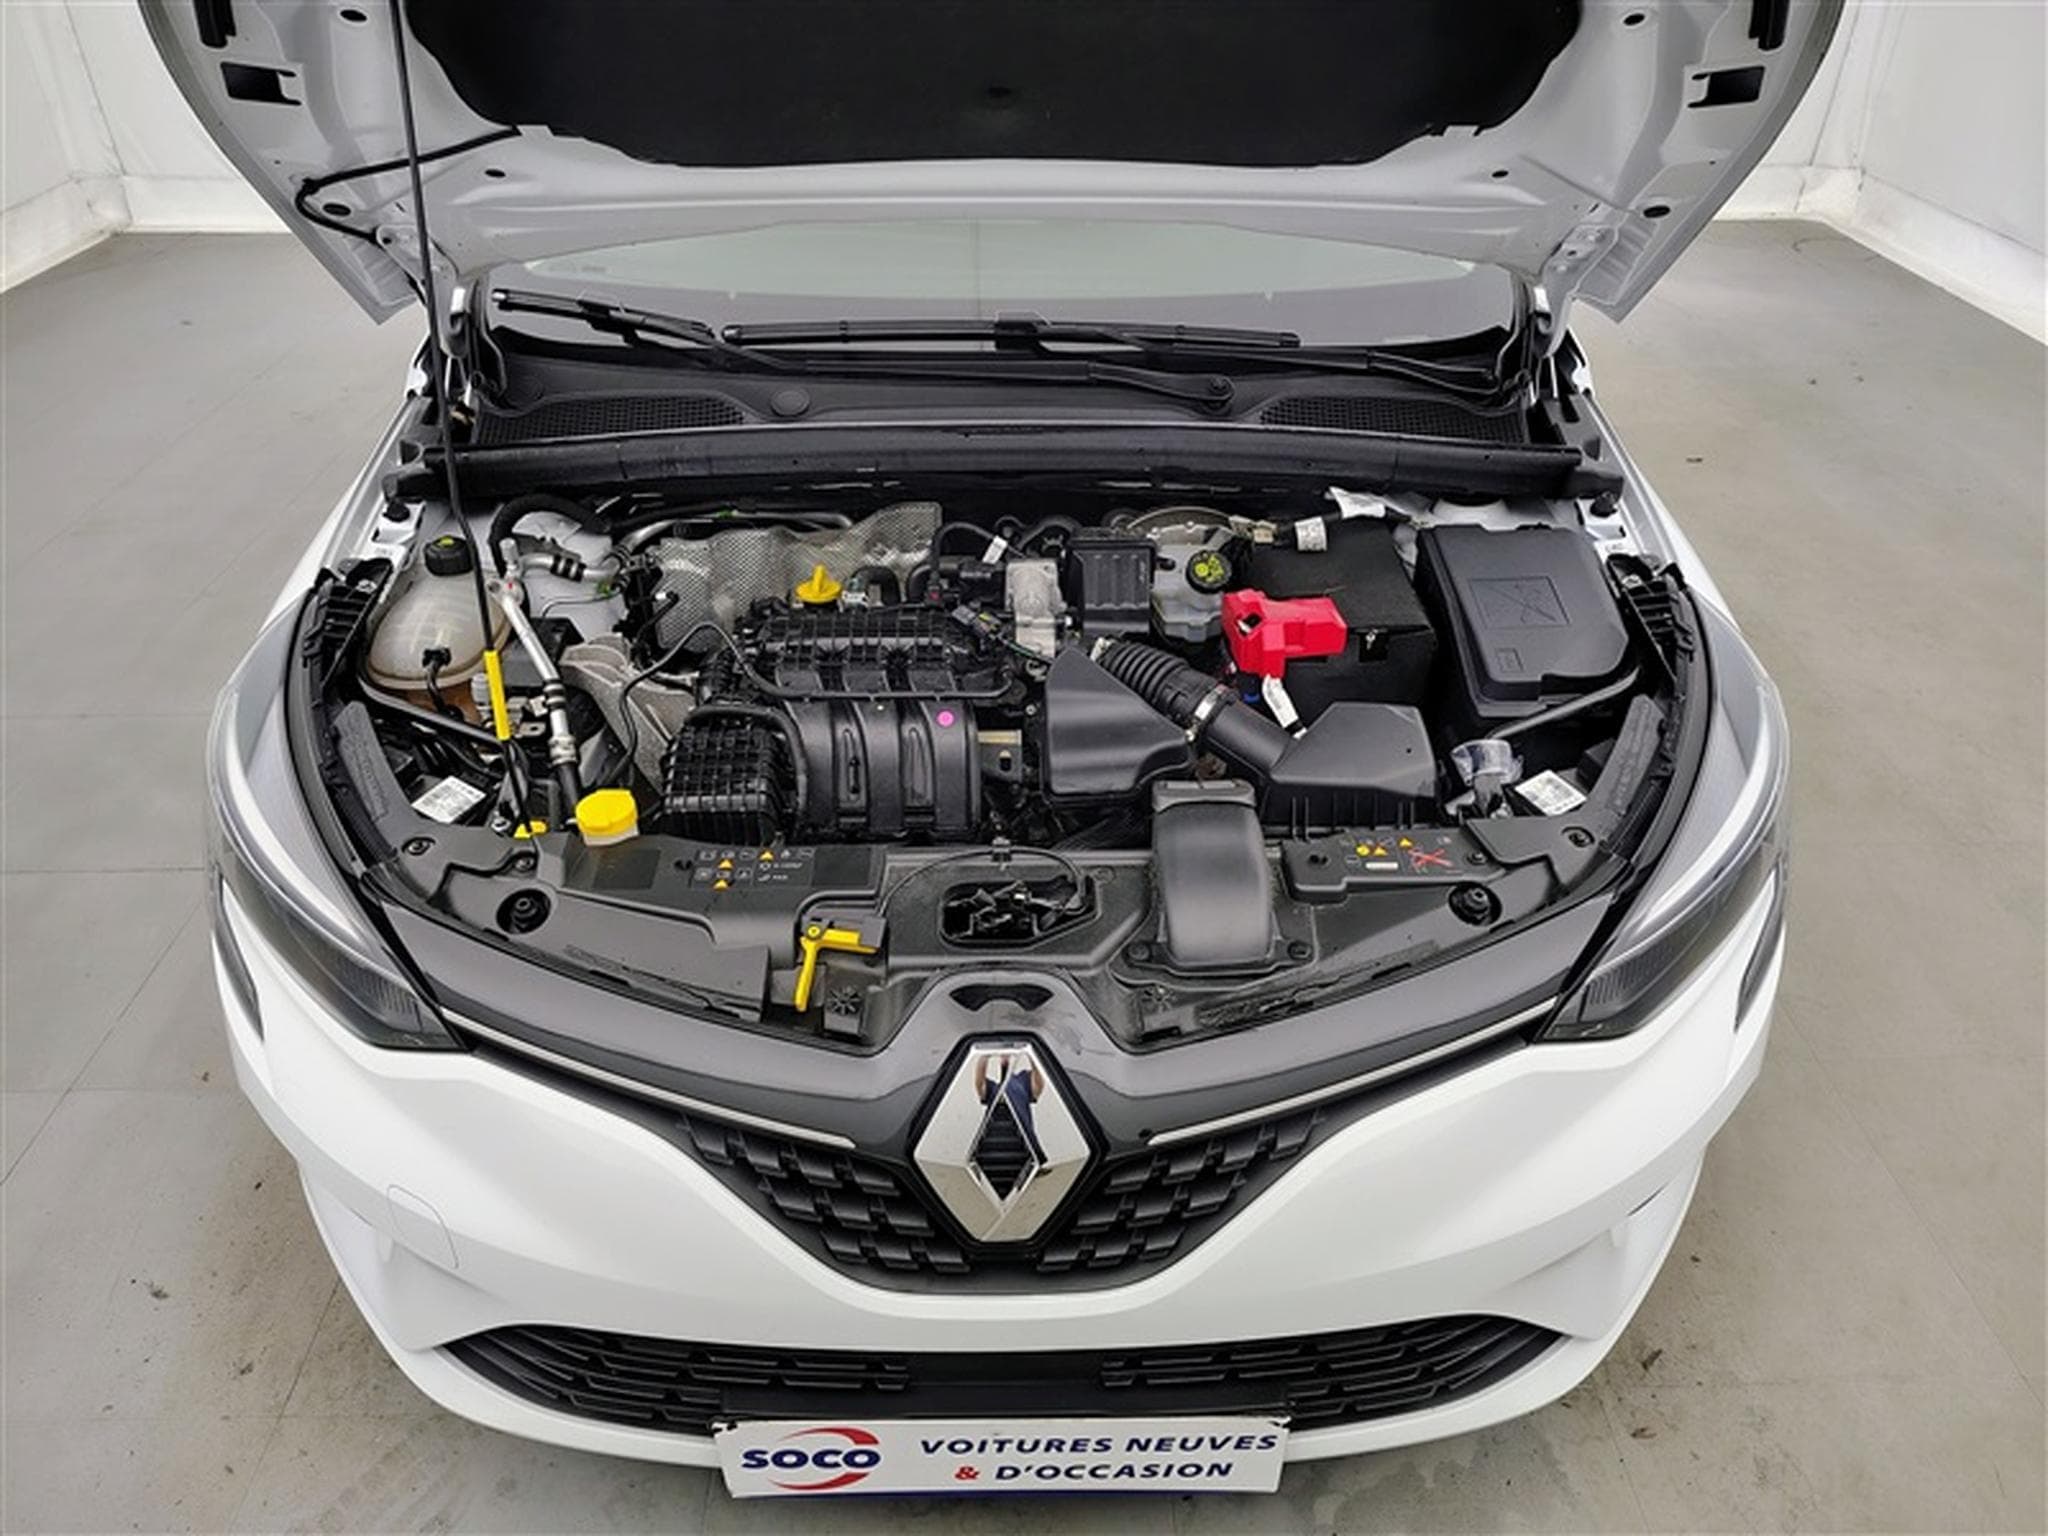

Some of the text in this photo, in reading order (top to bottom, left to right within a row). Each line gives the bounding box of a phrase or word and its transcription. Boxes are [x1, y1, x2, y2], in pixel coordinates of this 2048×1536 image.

[920, 1435, 1278, 1454] VOITURES NEUVES
[741, 1448, 881, 1469] SOCO
[954, 1462, 1233, 1481] & D'OCCASION
